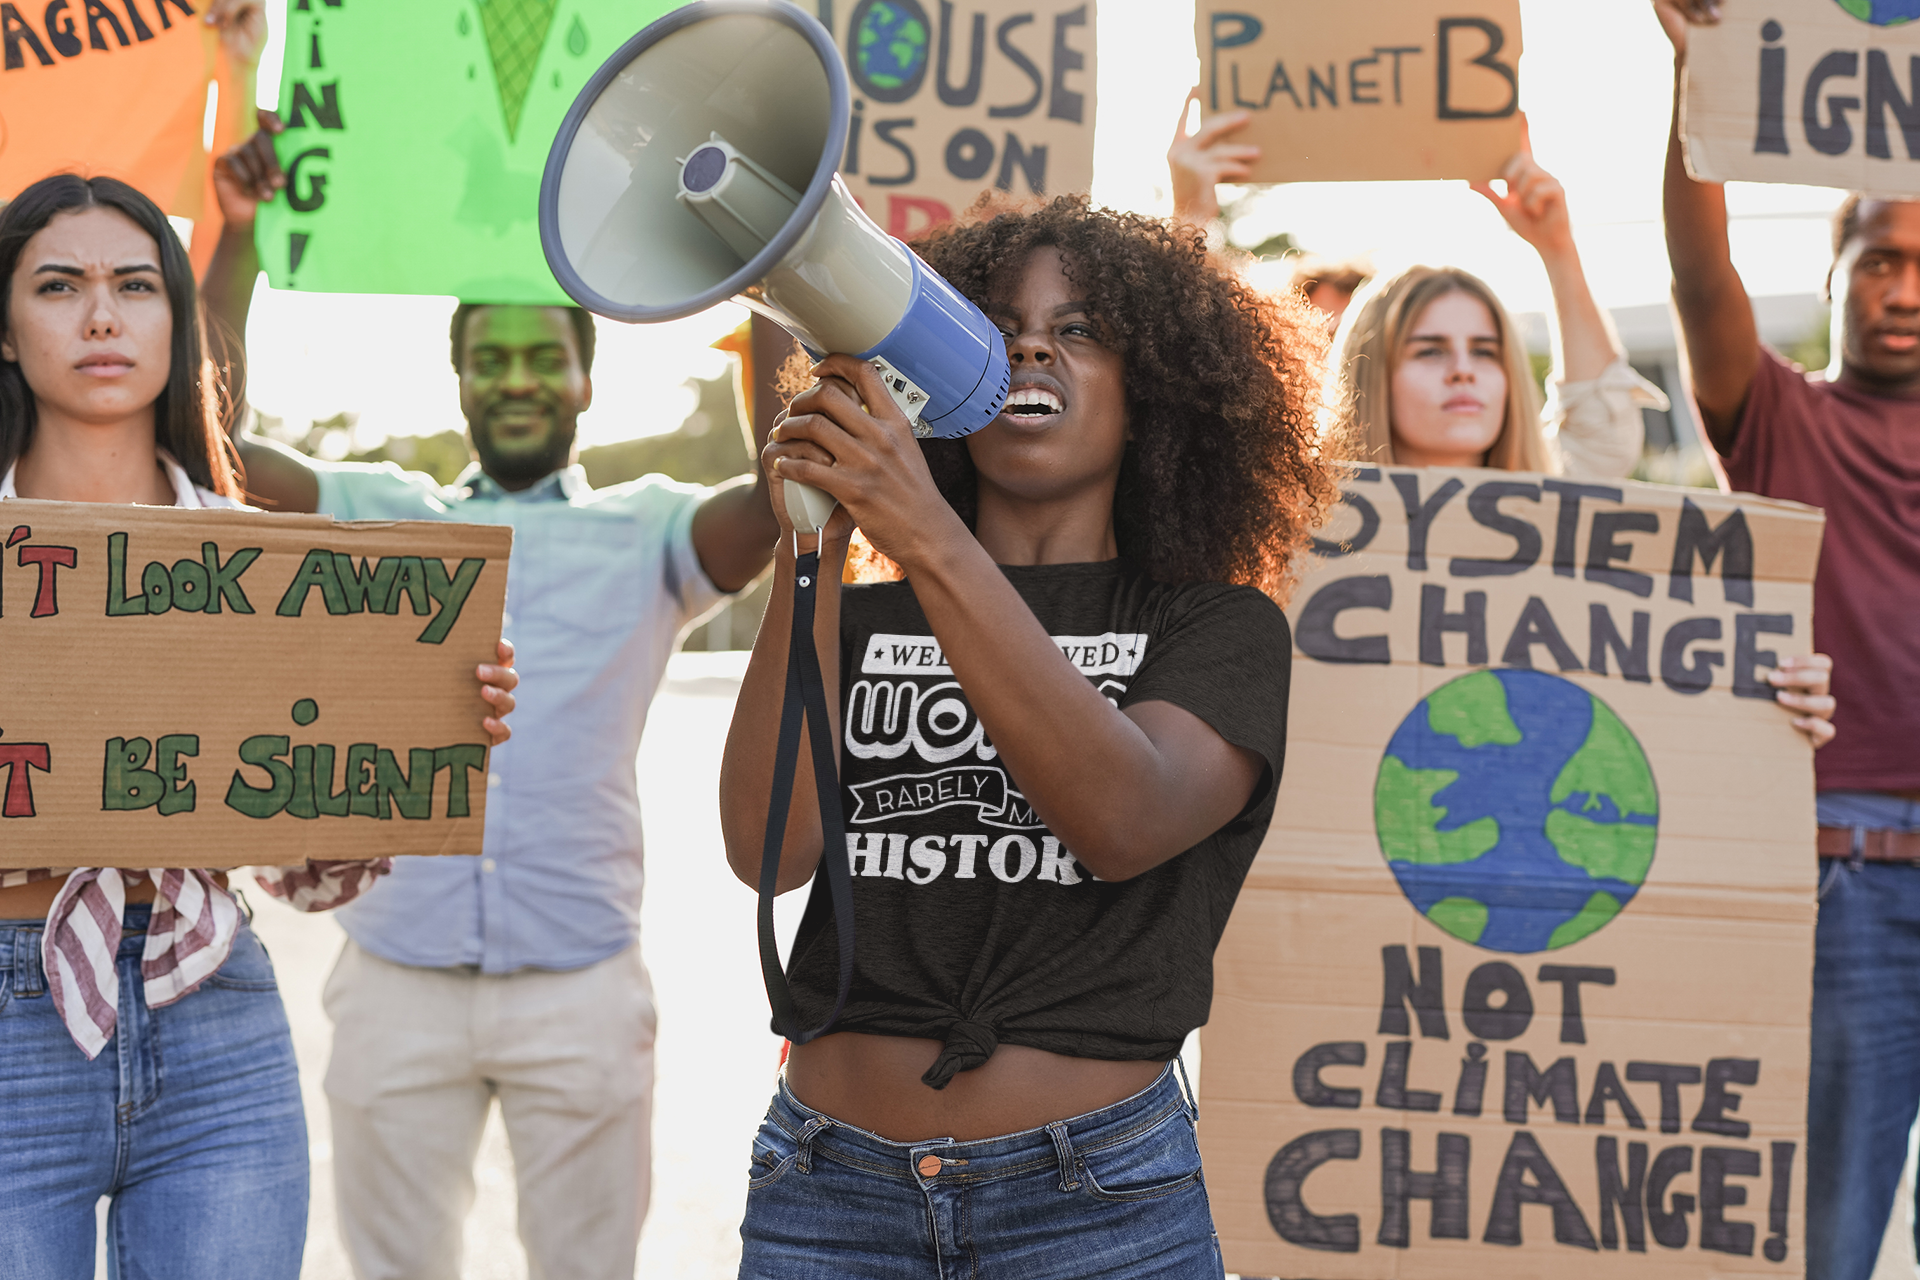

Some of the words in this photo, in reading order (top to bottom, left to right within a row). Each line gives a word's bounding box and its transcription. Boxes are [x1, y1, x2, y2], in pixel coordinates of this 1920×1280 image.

[818, 0, 1087, 125] OUSE
[1210, 10, 1424, 112] PLANET
[1436, 17, 1519, 120] B
[286, 0, 345, 288] iNG!
[945, 127, 1048, 196] ON
[1294, 574, 1794, 700] CHANGE
[101, 734, 200, 817] BE
[875, 775, 989, 813] RARELY
[846, 832, 1103, 885] HISTOR
[1377, 944, 1617, 1044] NOT
[1263, 1127, 1797, 1263] CHANGE!
